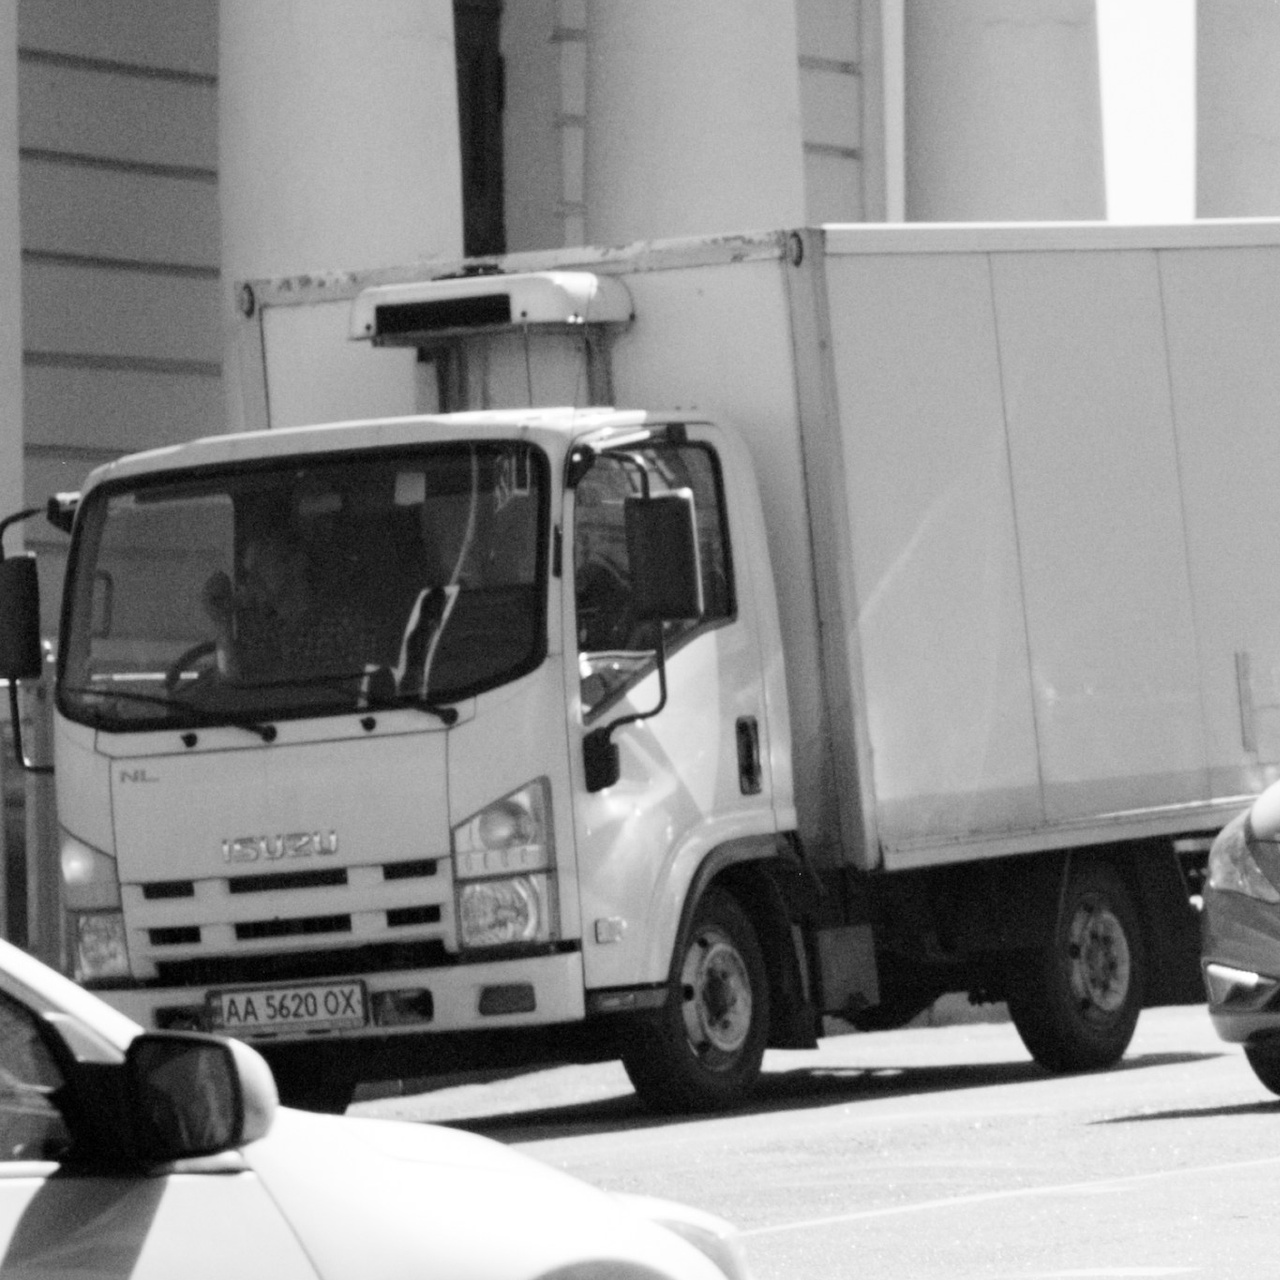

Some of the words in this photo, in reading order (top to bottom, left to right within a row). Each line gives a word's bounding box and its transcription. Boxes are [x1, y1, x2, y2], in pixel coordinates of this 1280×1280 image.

[221, 831, 338, 862] ISUZU
[226, 998, 258, 1022] AA
[265, 992, 318, 1020] 5620
[324, 989, 356, 1016] OX
